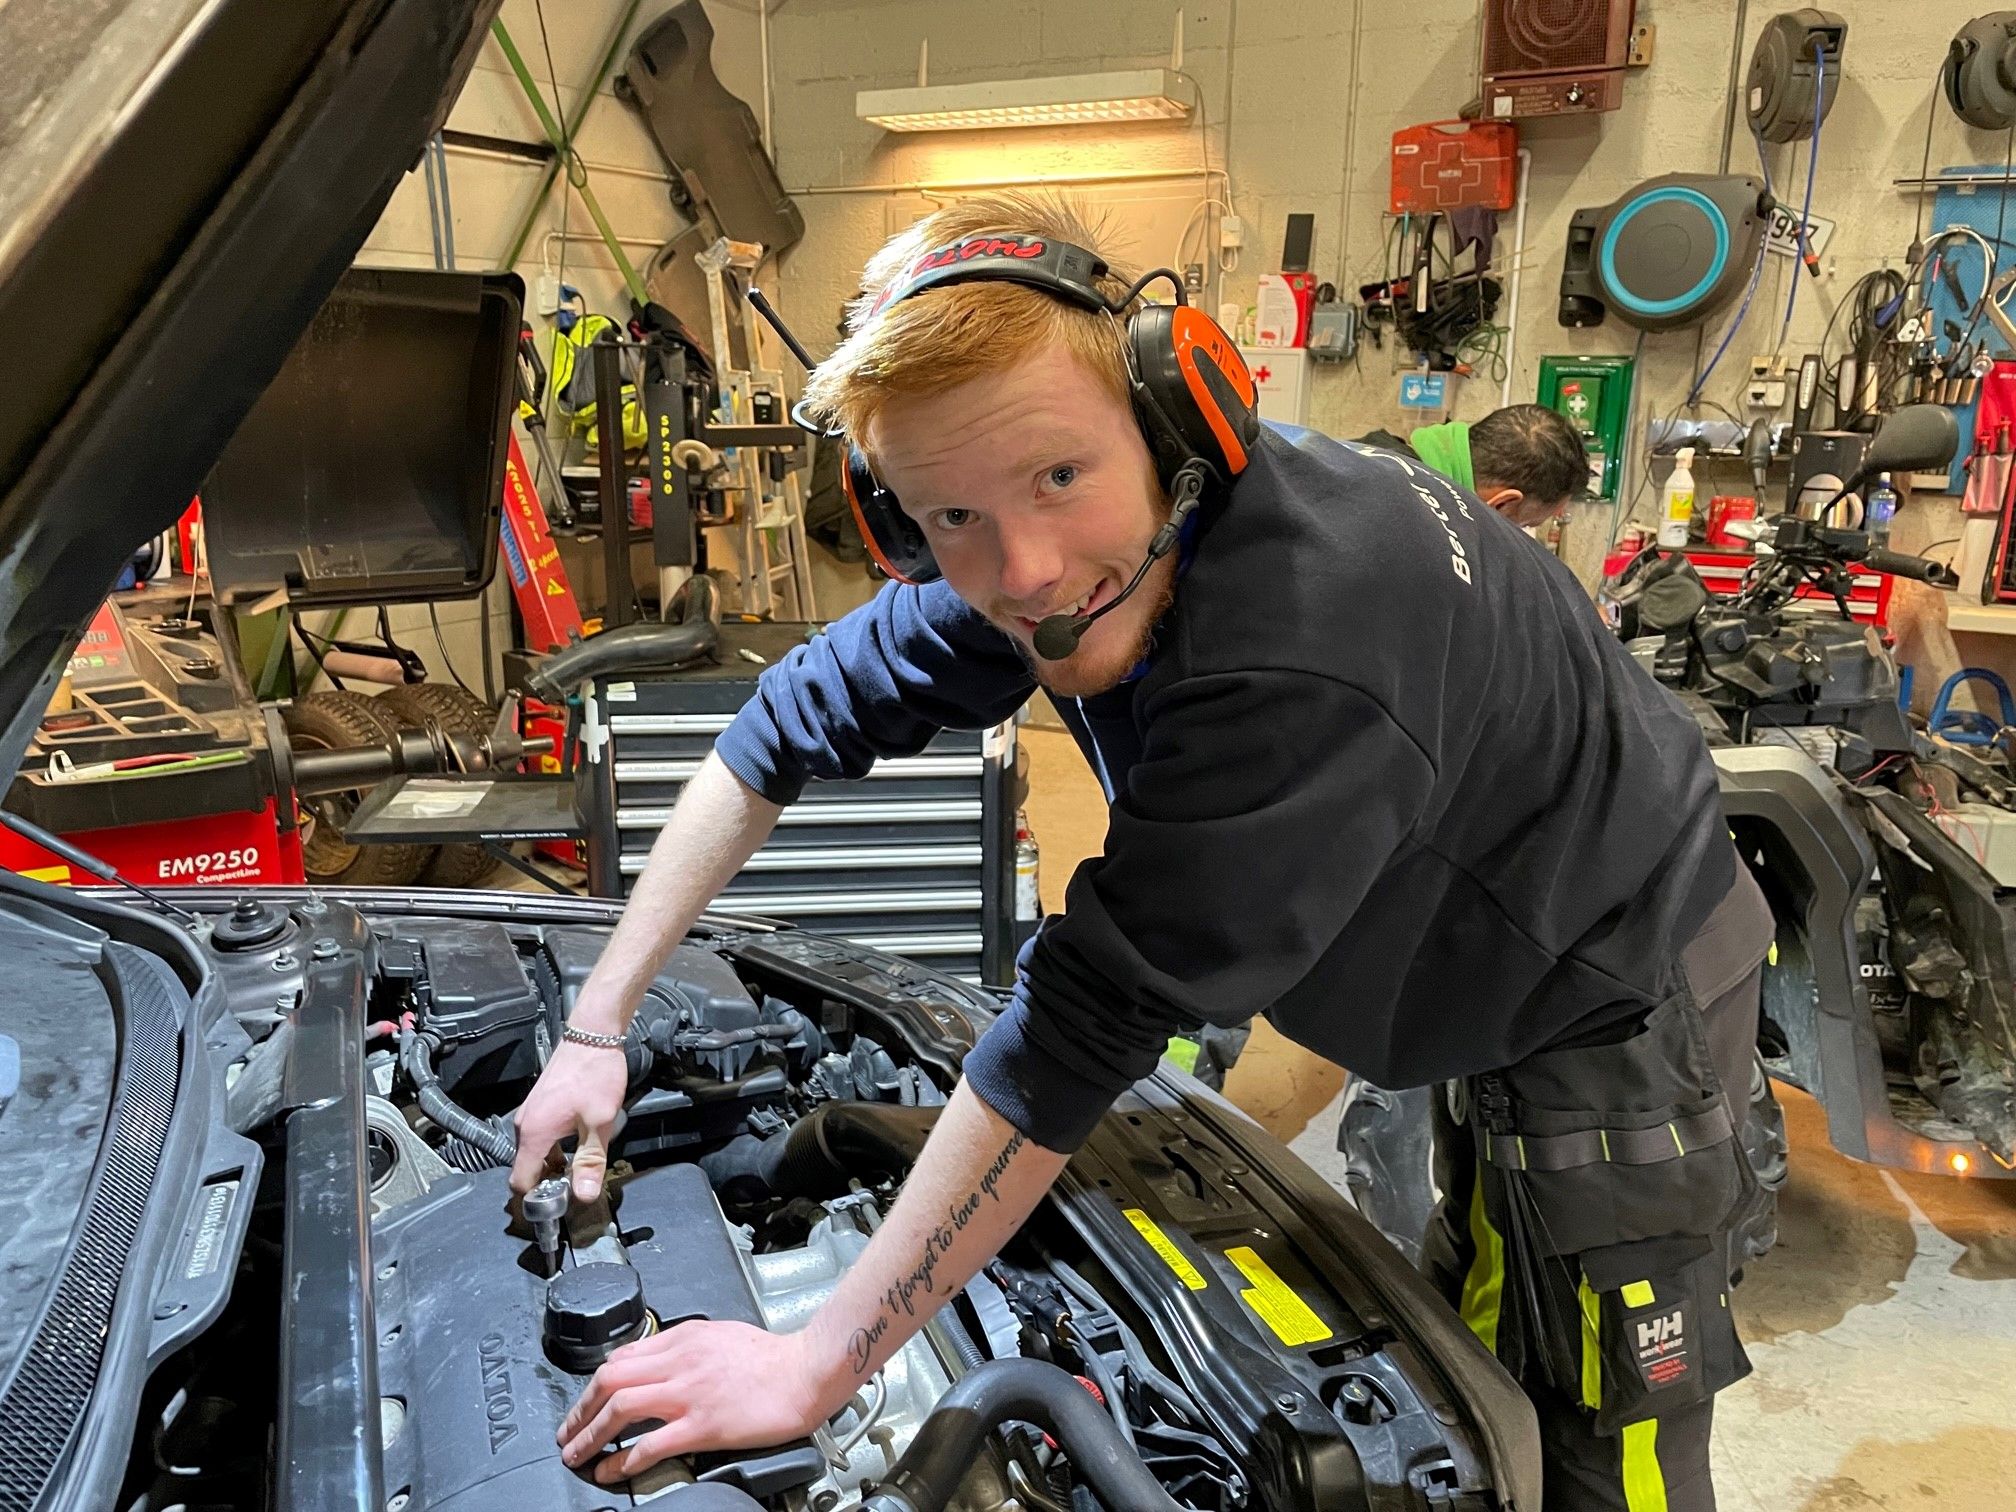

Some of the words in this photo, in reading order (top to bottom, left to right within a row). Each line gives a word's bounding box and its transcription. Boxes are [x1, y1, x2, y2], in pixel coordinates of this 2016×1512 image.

[1770, 210, 1820, 244] 947
[660, 414, 673, 495] SP2300
[158, 847, 259, 878] EM9250
[196, 868, 261, 884] CompactLine
[896, 1237, 939, 1316] forget
[933, 1226, 953, 1252] to
[950, 1192, 980, 1231] love
[980, 1130, 1023, 1202] yourse
[1637, 1311, 1683, 1348] HH
[478, 1333, 519, 1455] VOLVO
